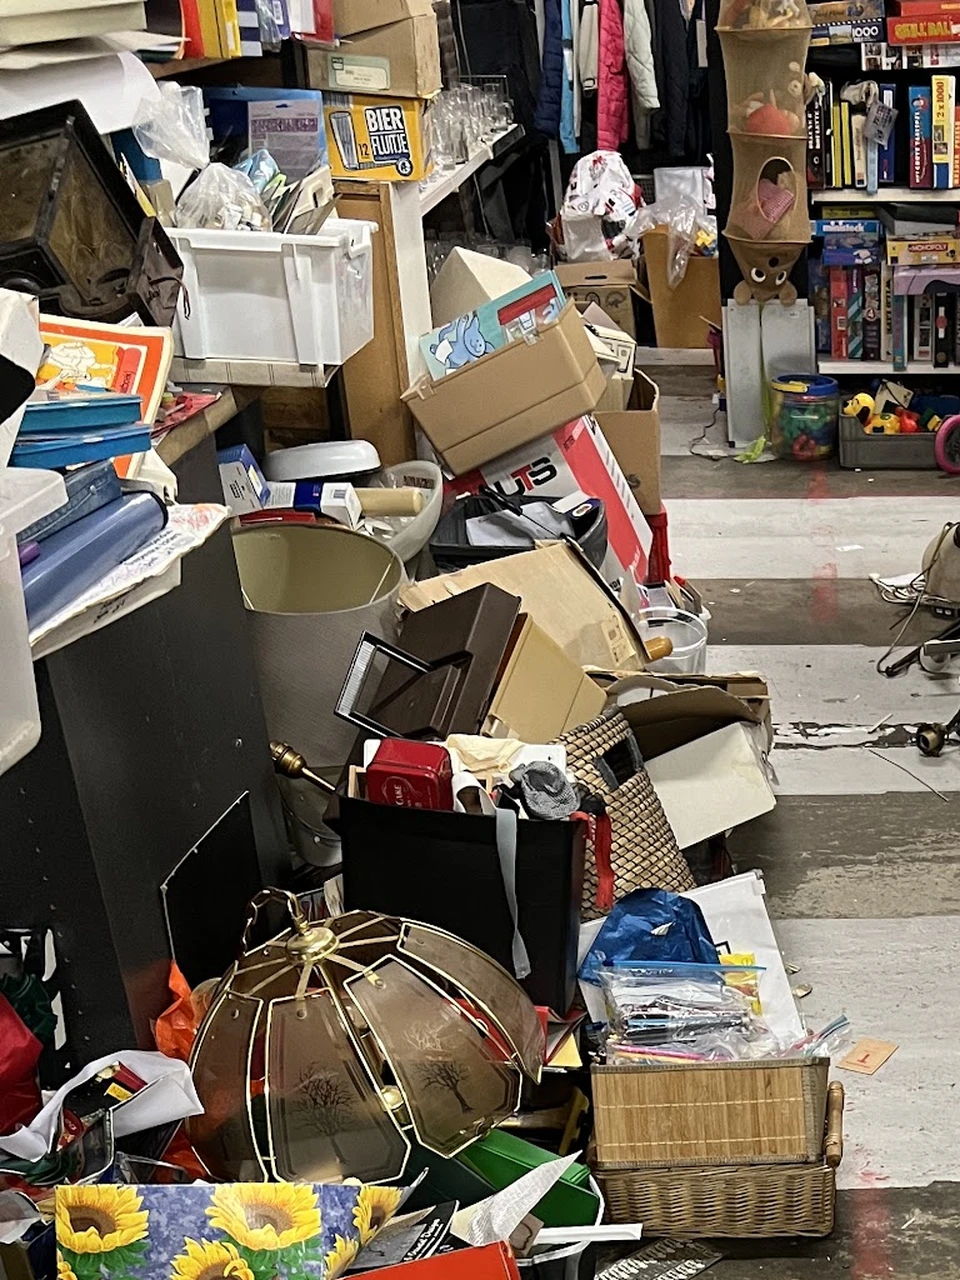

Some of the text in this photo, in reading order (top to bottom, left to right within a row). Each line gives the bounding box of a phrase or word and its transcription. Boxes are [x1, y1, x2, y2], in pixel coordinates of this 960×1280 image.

[852, 25, 879, 38] 1000
[936, 81, 945, 103] 1000
[365, 107, 405, 132] BIER
[358, 143, 370, 156] 12
[370, 133, 410, 156] FLUITJE
[910, 243, 948, 252] MONOPOLY
[393, 784, 404, 806] CAKE
